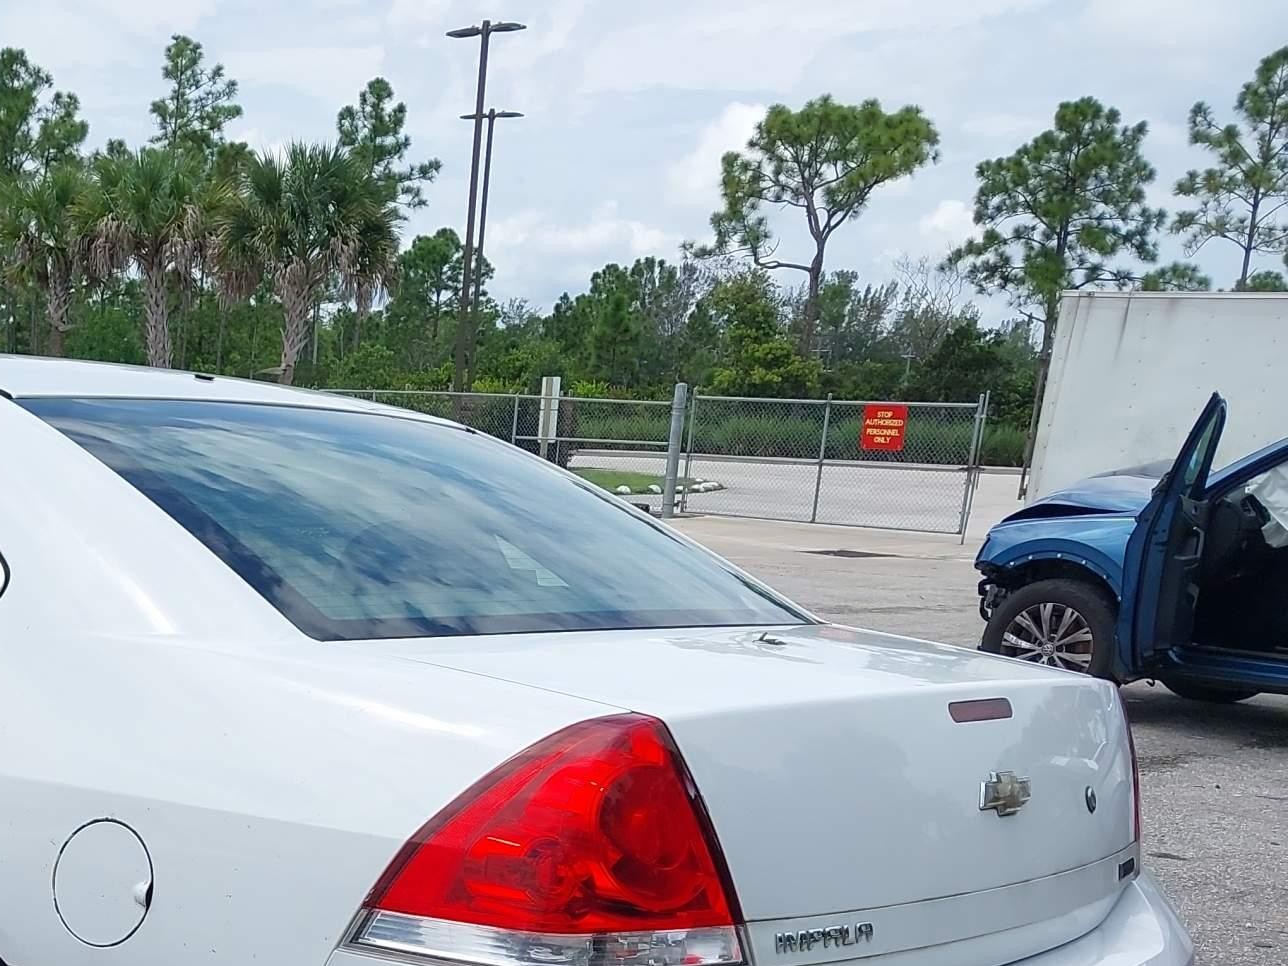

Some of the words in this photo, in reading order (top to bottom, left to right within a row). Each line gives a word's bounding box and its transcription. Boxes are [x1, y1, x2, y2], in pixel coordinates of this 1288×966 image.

[877, 411, 893, 419] STOP
[865, 418, 903, 427] AUTHORIZED
[866, 428, 900, 436] PERSONNEL
[873, 436, 891, 444] ONLY
[775, 922, 874, 955] IMPALA
